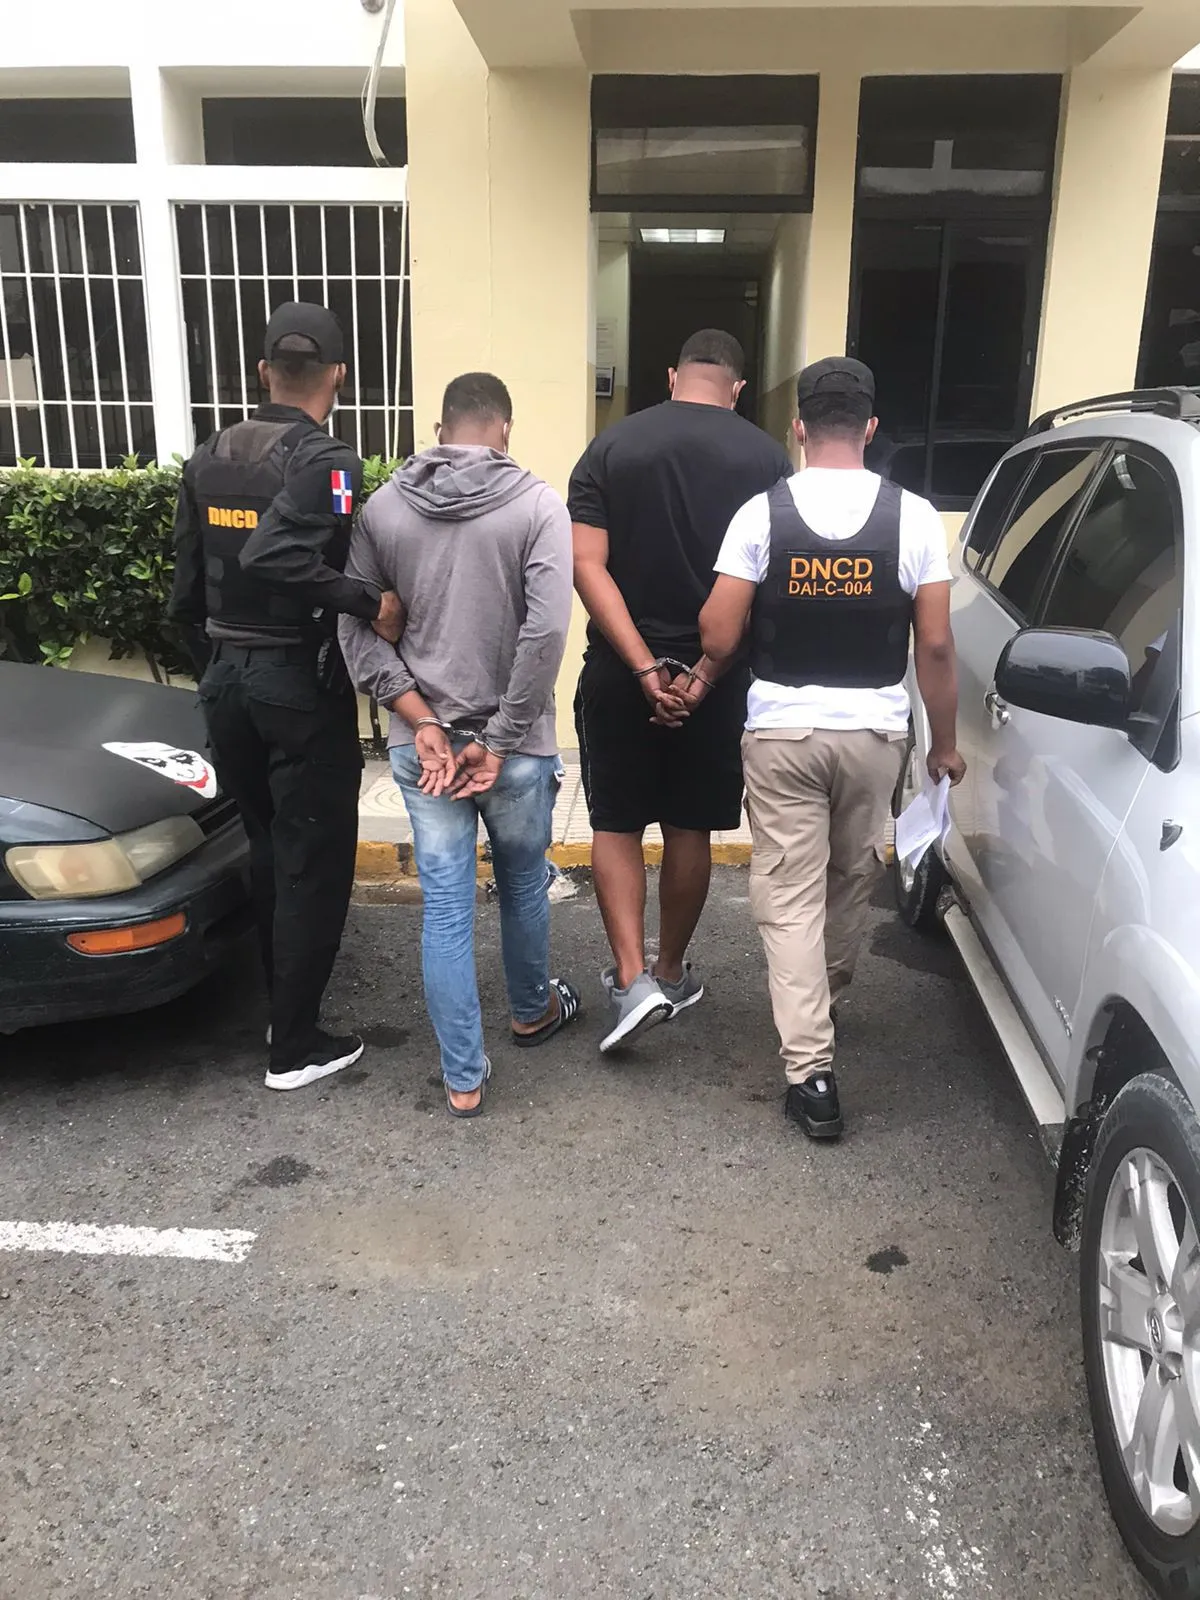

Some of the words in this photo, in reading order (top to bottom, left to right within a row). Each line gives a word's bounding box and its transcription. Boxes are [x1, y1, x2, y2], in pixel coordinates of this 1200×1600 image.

[207, 506, 259, 529] DNCD
[790, 557, 873, 580] DNCD
[788, 580, 872, 596] DAI-C-004
